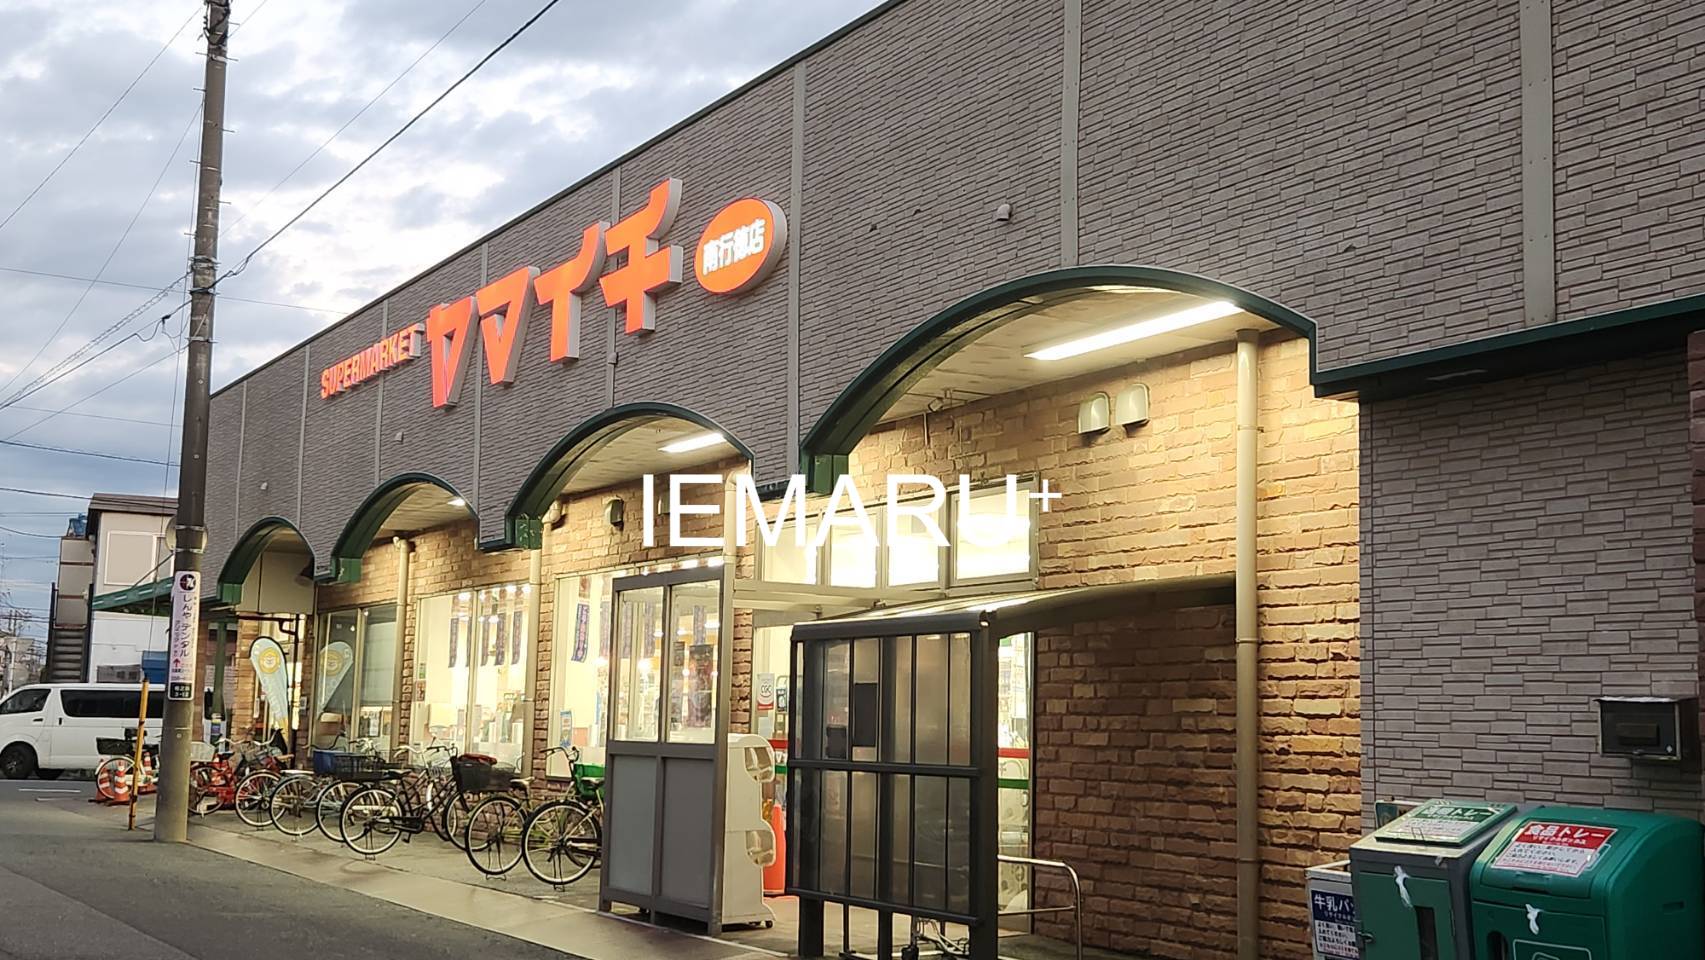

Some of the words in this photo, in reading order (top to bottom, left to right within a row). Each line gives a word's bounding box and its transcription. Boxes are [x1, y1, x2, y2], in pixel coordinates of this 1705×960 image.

[426, 178, 673, 408] ヤマイチ
[321, 323, 422, 400] SUPERMARKET
[1524, 824, 1605, 838] 食品トレー
